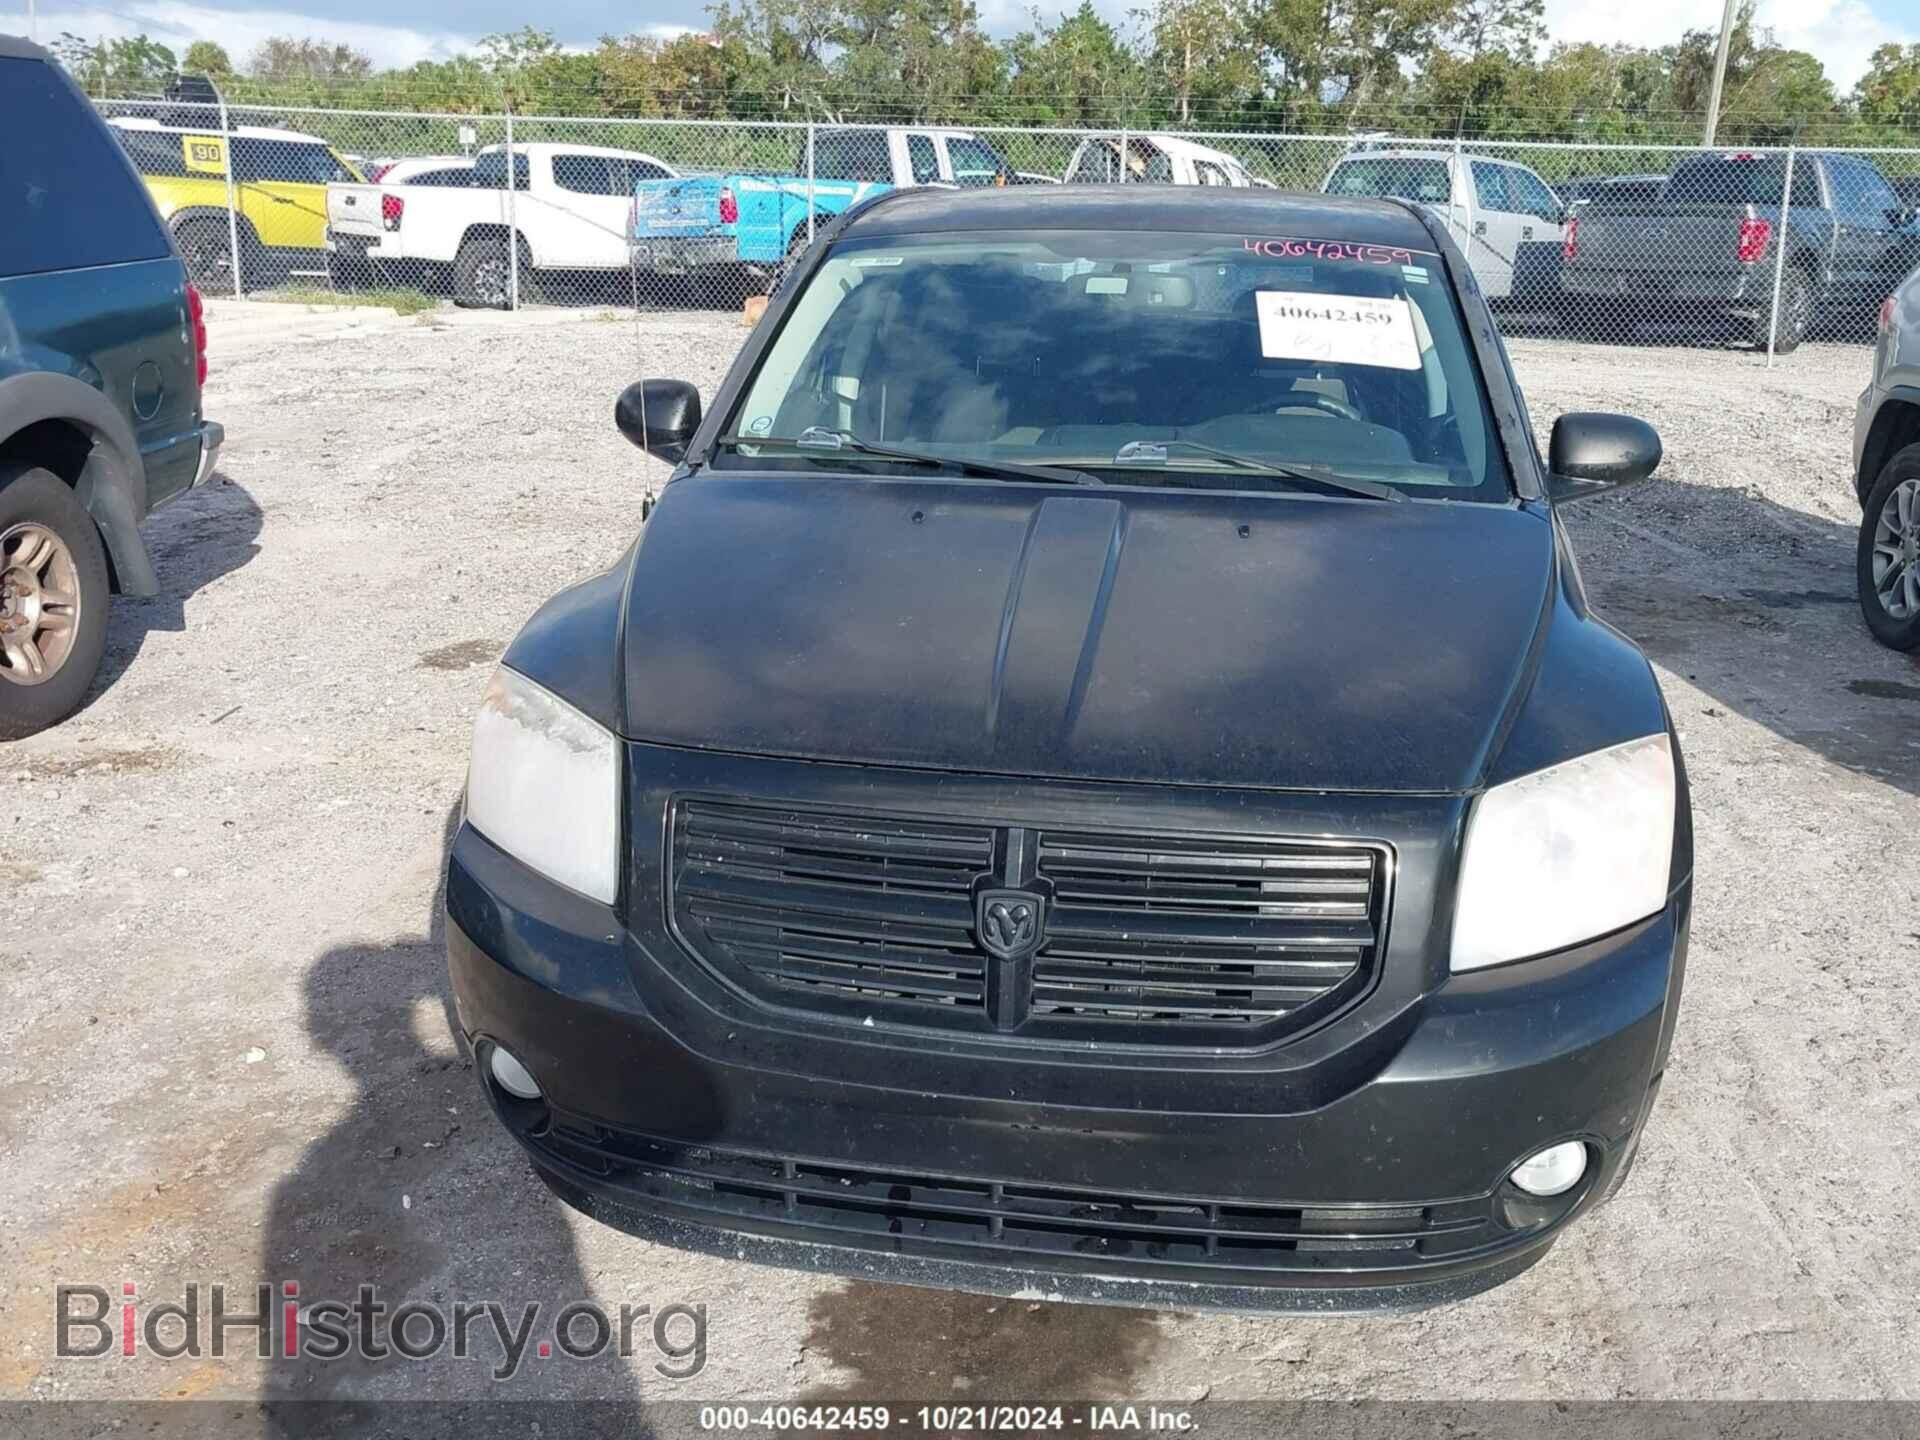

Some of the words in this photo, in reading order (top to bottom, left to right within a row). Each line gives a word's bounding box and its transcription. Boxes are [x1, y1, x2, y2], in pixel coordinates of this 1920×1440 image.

[196, 145, 219, 160] 90
[1244, 239, 1412, 266] 40642459
[1274, 305, 1393, 326] 40642459
